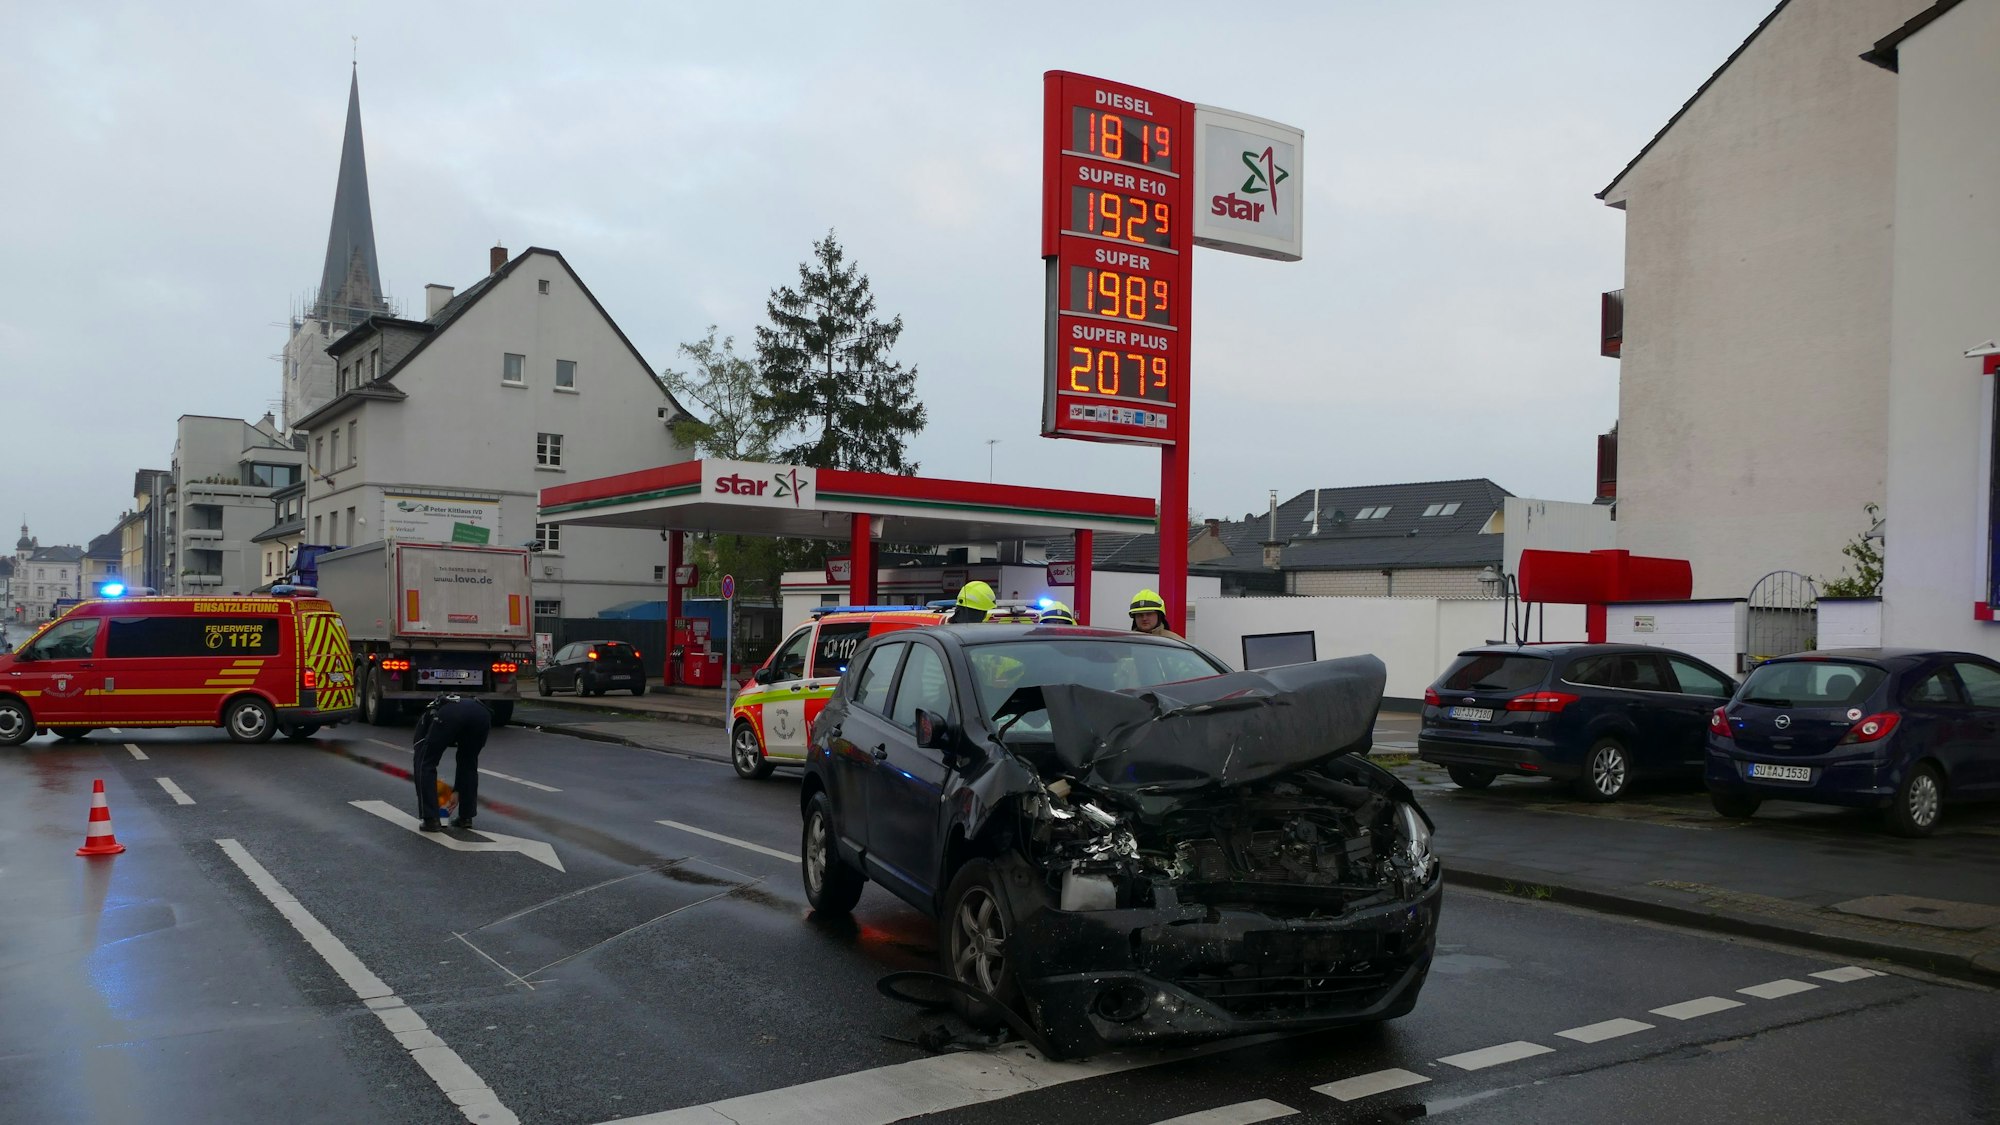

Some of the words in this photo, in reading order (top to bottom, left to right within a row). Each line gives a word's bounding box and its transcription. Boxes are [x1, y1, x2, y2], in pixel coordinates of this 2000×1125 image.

[1095, 89, 1153, 116] DIESEL
[1088, 112, 1170, 164] 1819
[1078, 166, 1135, 189] SUPER
[1139, 177, 1167, 197] E10
[1088, 192, 1169, 243] 1929
[1211, 192, 1265, 223] star
[1095, 248, 1150, 271] SUPER
[1087, 270, 1168, 320] 1989
[1072, 324, 1127, 345] SUPER
[1130, 332, 1168, 351] PLUS
[1070, 346, 1167, 396] 2079
[714, 472, 768, 497] star
[433, 574, 493, 585] www.lava.de
[831, 564, 843, 573] star
[193, 602, 279, 614] EINSATZLEITUNG
[205, 624, 263, 633] FEUERWEHR
[228, 633, 262, 648] 112
[839, 638, 857, 660] 112
[1754, 765, 1767, 776] SU
[1771, 766, 1785, 778] AJ
[1786, 768, 1809, 780] 1538
